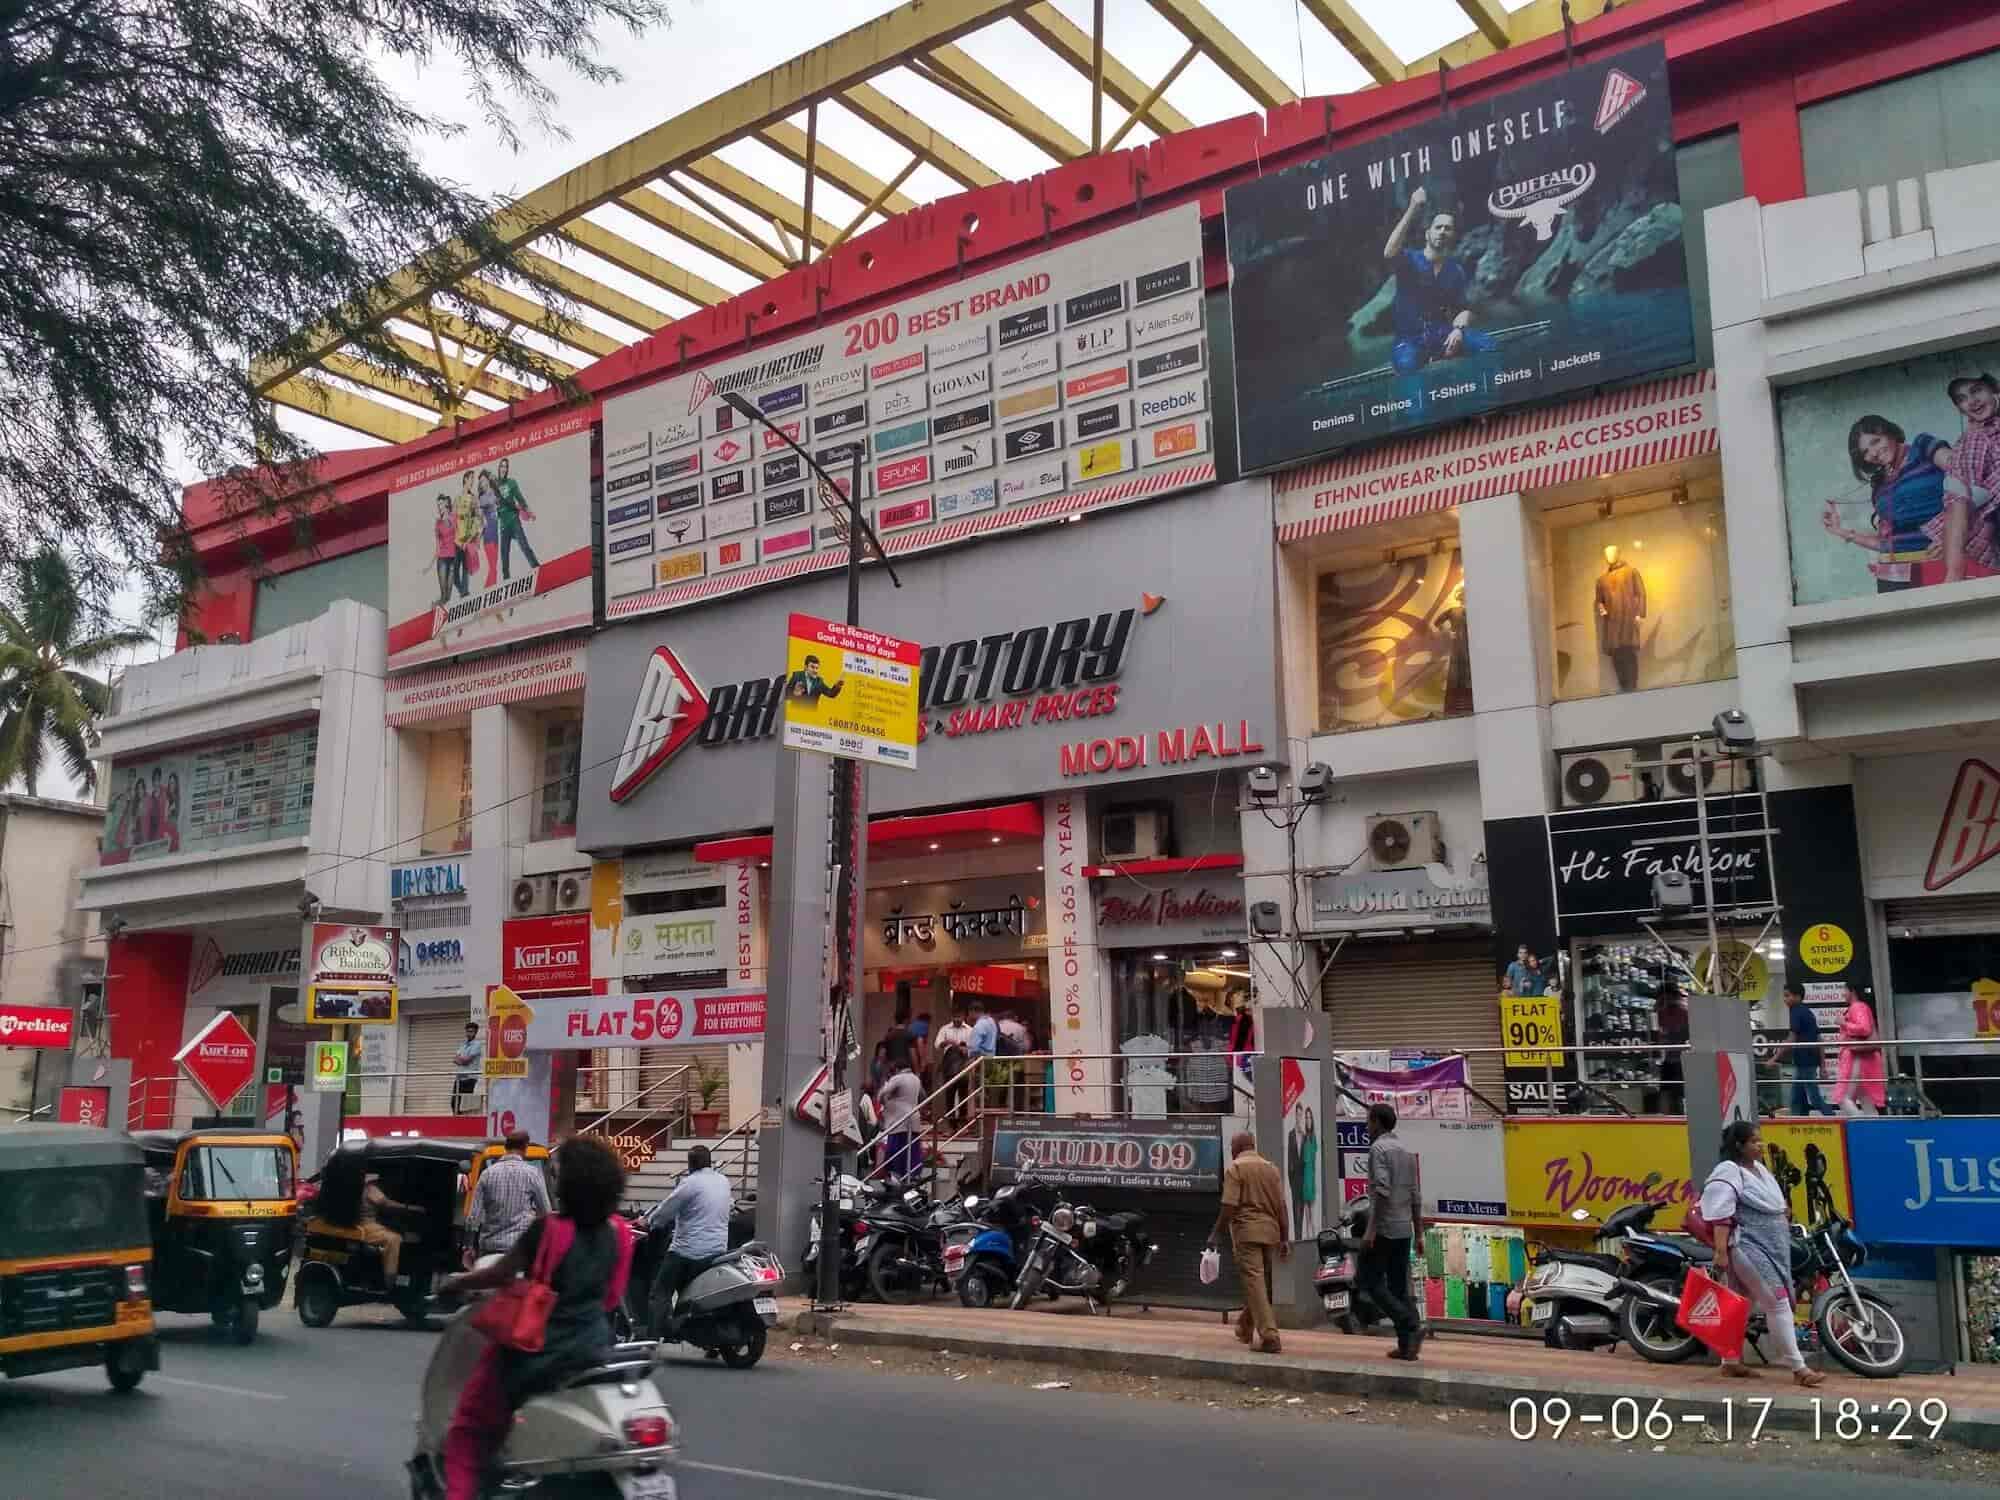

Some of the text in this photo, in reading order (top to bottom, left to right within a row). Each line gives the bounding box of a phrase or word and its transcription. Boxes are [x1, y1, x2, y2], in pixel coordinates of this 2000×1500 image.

[1307, 101, 1566, 211] ONE WITH ONESELF
[1499, 164, 1587, 207] BUFFALO
[844, 312, 899, 357] 200
[908, 300, 964, 336] BEST
[970, 273, 1051, 316] BRAND
[1149, 311, 1194, 330] Allen Solly
[713, 344, 824, 396] BRAND FACTORY
[813, 366, 862, 391] ARROW
[933, 369, 985, 395] GIOVANI
[1312, 349, 1601, 431] Denims Chinos T-Shirts Shirts Jackets
[1142, 391, 1197, 416] Reebok
[883, 463, 920, 481] SPUNK
[483, 575, 533, 609] FACTORY
[828, 623, 900, 649] Get Ready for
[840, 638, 855, 649] Job
[878, 646, 896, 658] days
[945, 700, 1028, 738] SMART
[1031, 684, 1120, 724] PRICES
[1060, 719, 1263, 777] MODI MALL
[1057, 805, 1072, 857] YEAR
[1062, 862, 1073, 876] A
[1560, 845, 1757, 883] Hi Fashion
[1062, 885, 1077, 923] 365
[1820, 927, 1831, 941] 6
[340, 957, 384, 969] Balloons
[739, 933, 751, 980] BEST
[704, 1003, 716, 1014] ON
[1512, 1003, 1547, 1016] FLAT
[567, 1011, 628, 1037] FLAT
[704, 1018, 719, 1030] FOR
[1510, 1022, 1555, 1046] 90%
[1509, 1084, 1566, 1099] SALE
[1016, 1138, 1195, 1170] STUDIO 99
[1068, 1172, 1111, 1185] Garments
[1120, 1175, 1150, 1186] Ladies
[1446, 1201, 1466, 1214] For
[1467, 1201, 1498, 1215] Mens
